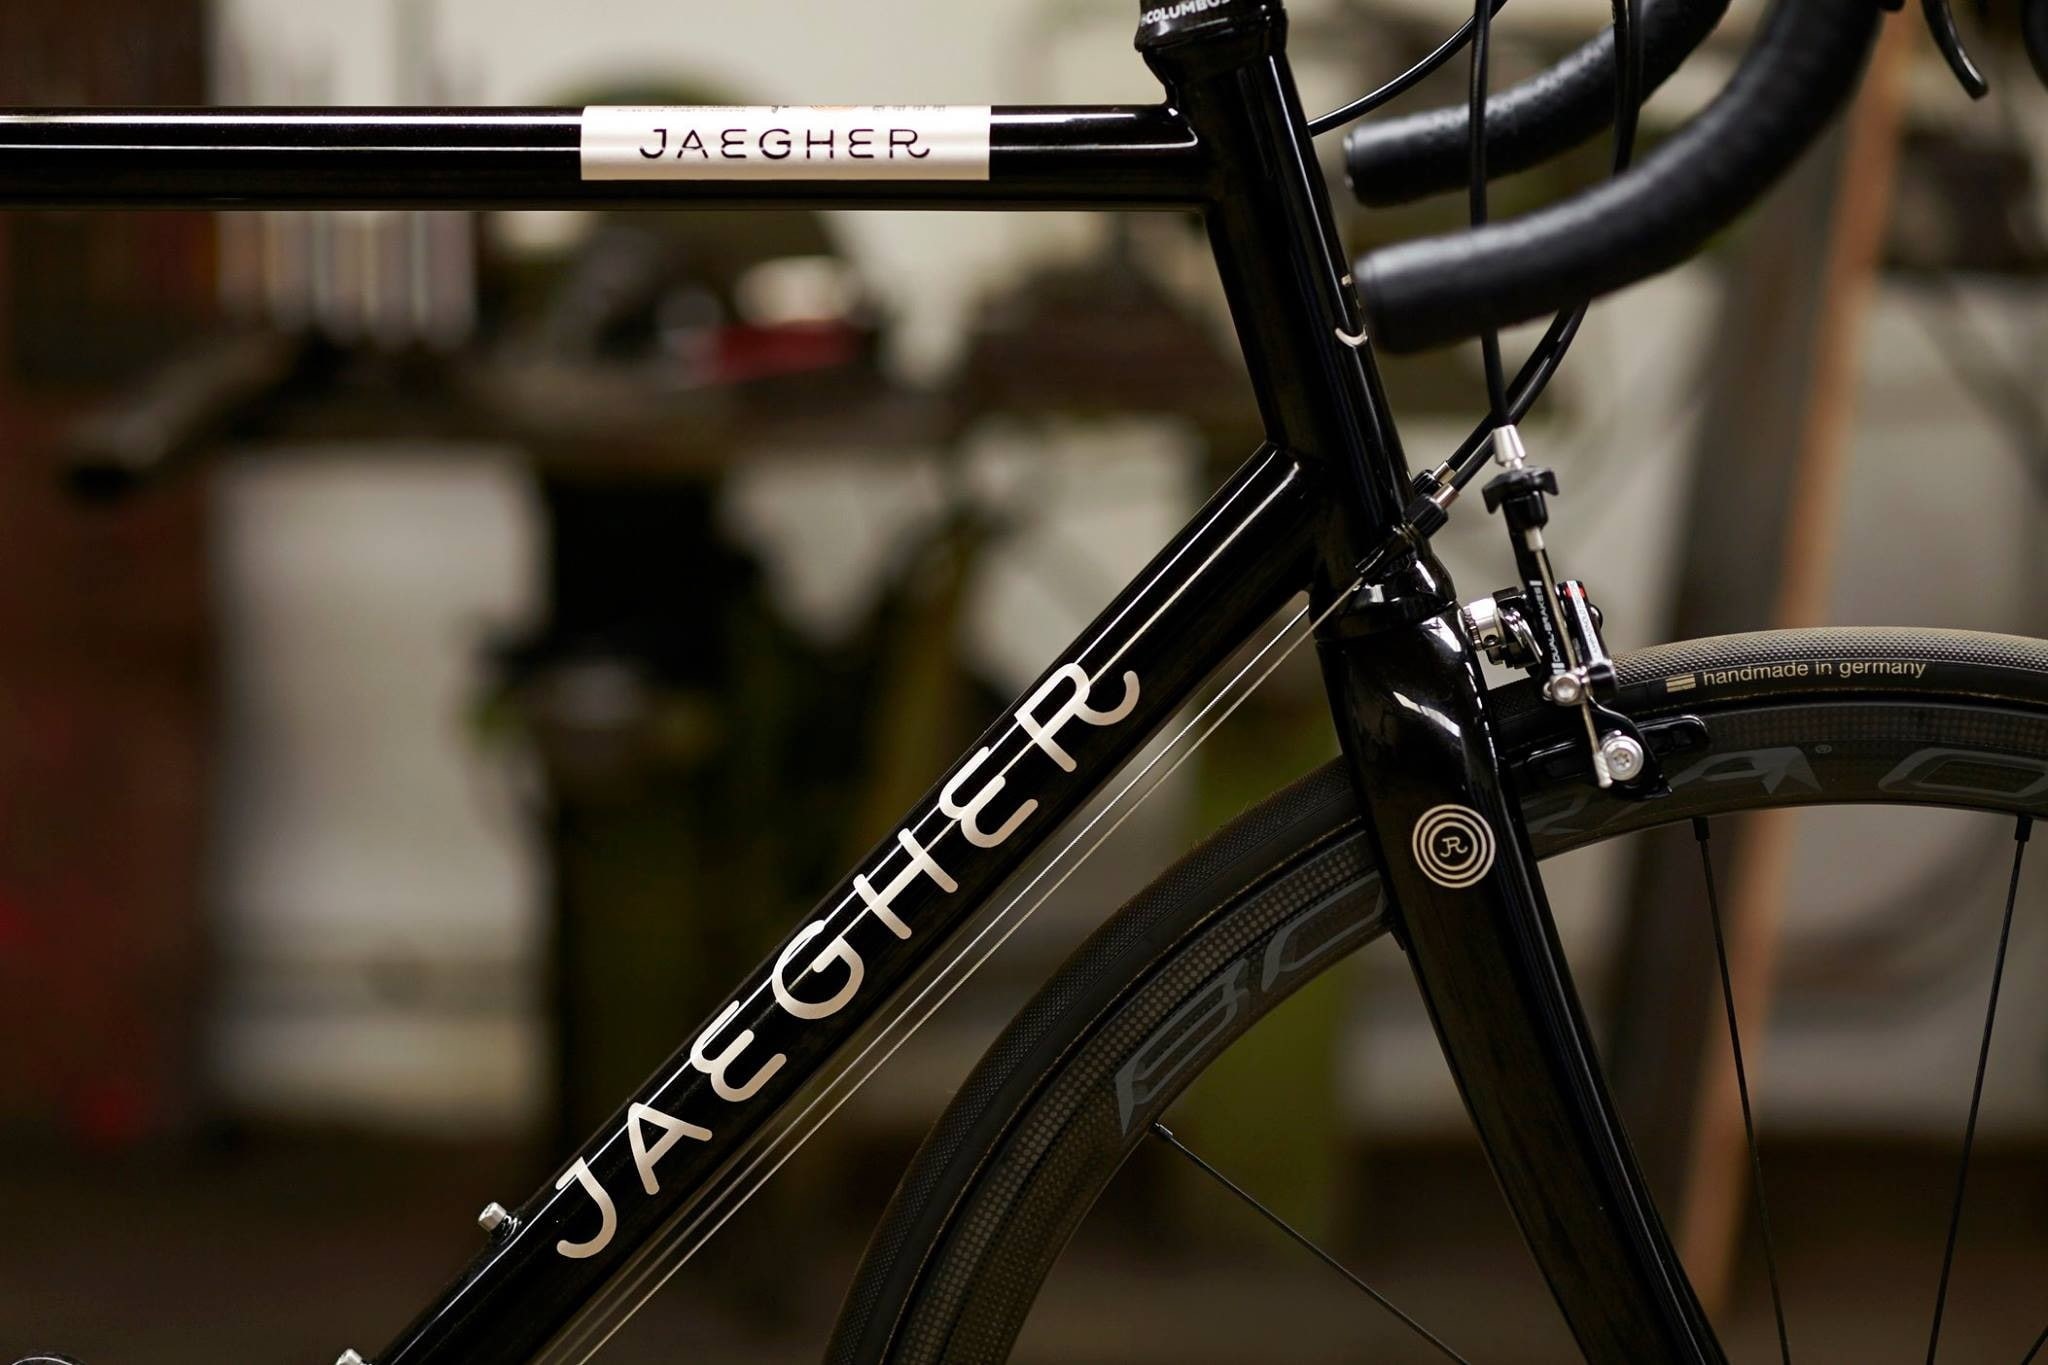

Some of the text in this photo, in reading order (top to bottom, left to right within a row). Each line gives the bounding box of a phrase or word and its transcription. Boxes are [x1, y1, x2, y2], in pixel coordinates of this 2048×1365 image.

[1146, 0, 1231, 24] COLUMBU
[639, 128, 931, 160] JAEGHER
[1703, 660, 1927, 686] handmade in germany
[555, 662, 1140, 1259] JAEGHER
